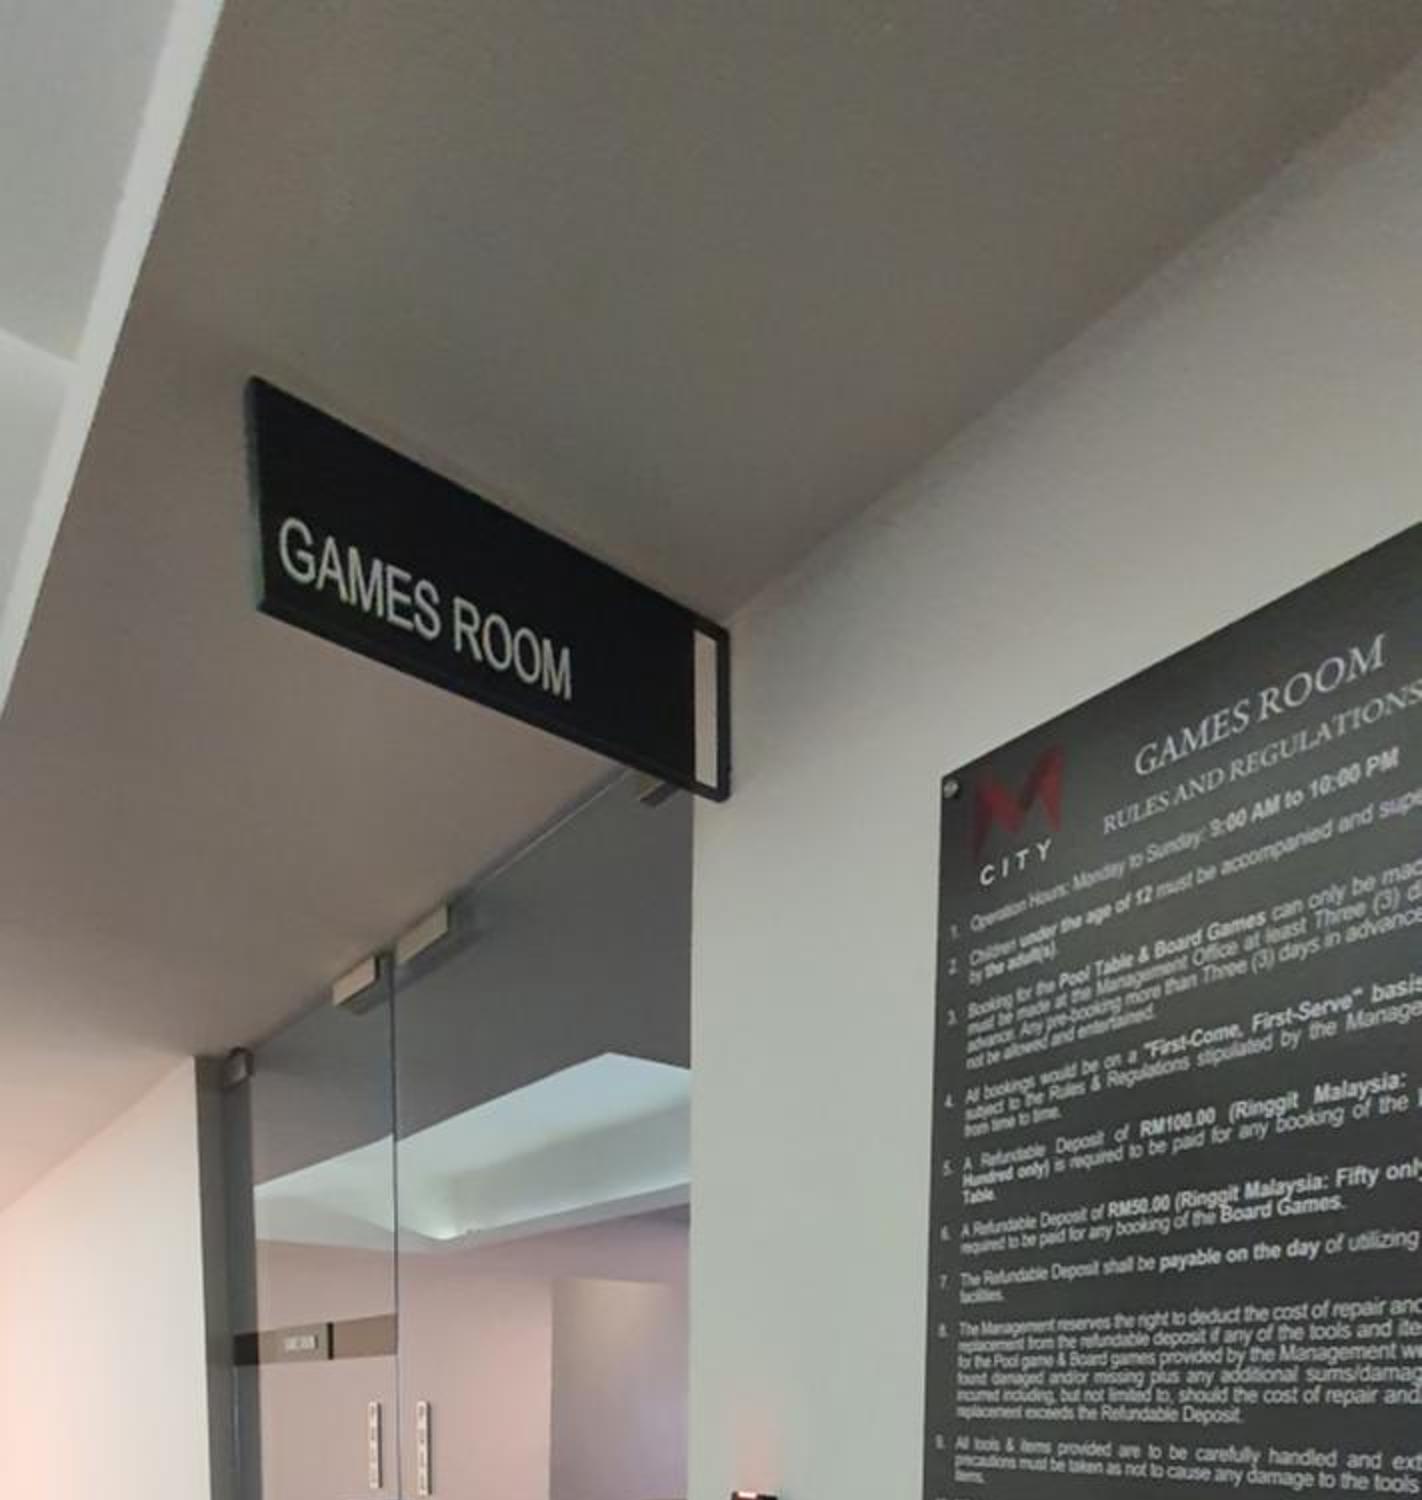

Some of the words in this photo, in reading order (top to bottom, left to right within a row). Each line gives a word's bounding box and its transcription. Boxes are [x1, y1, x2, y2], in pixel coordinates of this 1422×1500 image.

[279, 517, 442, 641] GAMES
[453, 595, 573, 701] ROOM
[1135, 698, 1251, 776] GAMES
[1256, 632, 1388, 719] ROOM
[1103, 789, 1171, 835] RULES
[1175, 767, 1225, 810] AND
[1128, 853, 1145, 870] to
[1250, 794, 1281, 823] AM
[1283, 789, 1304, 809] to
[1309, 762, 1362, 799] 10:00
[1365, 746, 1400, 778] PM
[979, 838, 1054, 886] CITY
[1114, 892, 1132, 914] of
[1135, 885, 1153, 906] 12
[1155, 871, 1193, 899] must
[1196, 865, 1217, 885] be
[1220, 818, 1334, 876] accompanied
[1337, 803, 1374, 834] and
[1137, 945, 1150, 964] &
[1154, 928, 1203, 960] Board
[1206, 911, 1267, 942] Games
[1271, 899, 1305, 922] can
[1307, 884, 1347, 910] only
[1351, 875, 1377, 897] be
[1191, 941, 1239, 967] Office
[1243, 931, 1261, 952] at
[1264, 916, 1307, 944] least
[1314, 901, 1367, 929] Three
[1371, 887, 1402, 916] (3)
[1164, 973, 1198, 996] than
[1201, 959, 1248, 983] Three
[1251, 947, 1275, 974] (3)
[1278, 937, 1321, 962] days
[1323, 931, 1342, 948] in
[1196, 1032, 1274, 1067] stipulated
[1279, 1029, 1302, 1049] by
[1308, 1020, 1338, 1040] the
[1128, 1143, 1144, 1159] to
[1148, 1138, 1168, 1156] be
[1171, 1129, 1206, 1155] paid
[1211, 1126, 1233, 1144] for
[1238, 1121, 1270, 1140] any
[1275, 1106, 1345, 1133] booking
[1351, 1098, 1373, 1120] of
[1378, 1094, 1410, 1115] the
[1140, 1106, 1216, 1138] RM100.00
[1228, 1091, 1299, 1124] (Ringgit
[1107, 1194, 1171, 1218] RM50.00
[1174, 1185, 1240, 1213] (Ringgit
[1335, 1165, 1380, 1188] Fifty
[1172, 1210, 1191, 1230] of
[1192, 1209, 1217, 1227] the
[1218, 1200, 1273, 1224] Board
[1137, 1256, 1156, 1272] be
[1159, 1248, 1222, 1273] payable
[1225, 1247, 1249, 1263] on
[1253, 1242, 1282, 1261] the
[1286, 1238, 1321, 1260] day
[1324, 1232, 1345, 1254] of
[1348, 1229, 1421, 1252] utilizing
[1171, 1311, 1187, 1326] to
[1188, 1306, 1241, 1326] deduct
[1243, 1305, 1270, 1323] the
[1272, 1302, 1309, 1321] cost
[1310, 1299, 1330, 1320] of
[1331, 1300, 1388, 1320] repair
[1209, 1326, 1221, 1344] if
[1223, 1329, 1254, 1345] any
[1255, 1323, 1275, 1343] of
[1277, 1323, 1305, 1342] the
[1308, 1321, 1353, 1341] tools
[1356, 1318, 1393, 1339] and
[1159, 1346, 1224, 1366] provided
[1225, 1346, 1247, 1365] by
[1249, 1345, 1276, 1363] the
[1279, 1341, 1398, 1363] Management
[1185, 1370, 1215, 1386] any
[1219, 1364, 1299, 1384] additional
[1178, 1386, 1229, 1404] should
[1232, 1386, 1259, 1404] the
[1262, 1386, 1299, 1404] cost
[1302, 1385, 1322, 1404] of
[1325, 1386, 1379, 1407] repair
[1147, 1444, 1163, 1460] to
[1168, 1444, 1189, 1461] be
[1194, 1444, 1262, 1468] carefully
[1268, 1447, 1338, 1468] handled
[1346, 1452, 1383, 1470] and
[1149, 1462, 1165, 1479] to
[1165, 1465, 1212, 1481] cause
[1214, 1468, 1244, 1486] any
[1246, 1466, 1315, 1490] damage
[1317, 1470, 1337, 1489] to
[1340, 1471, 1370, 1491] the
[1373, 1474, 1421, 1494] tools
